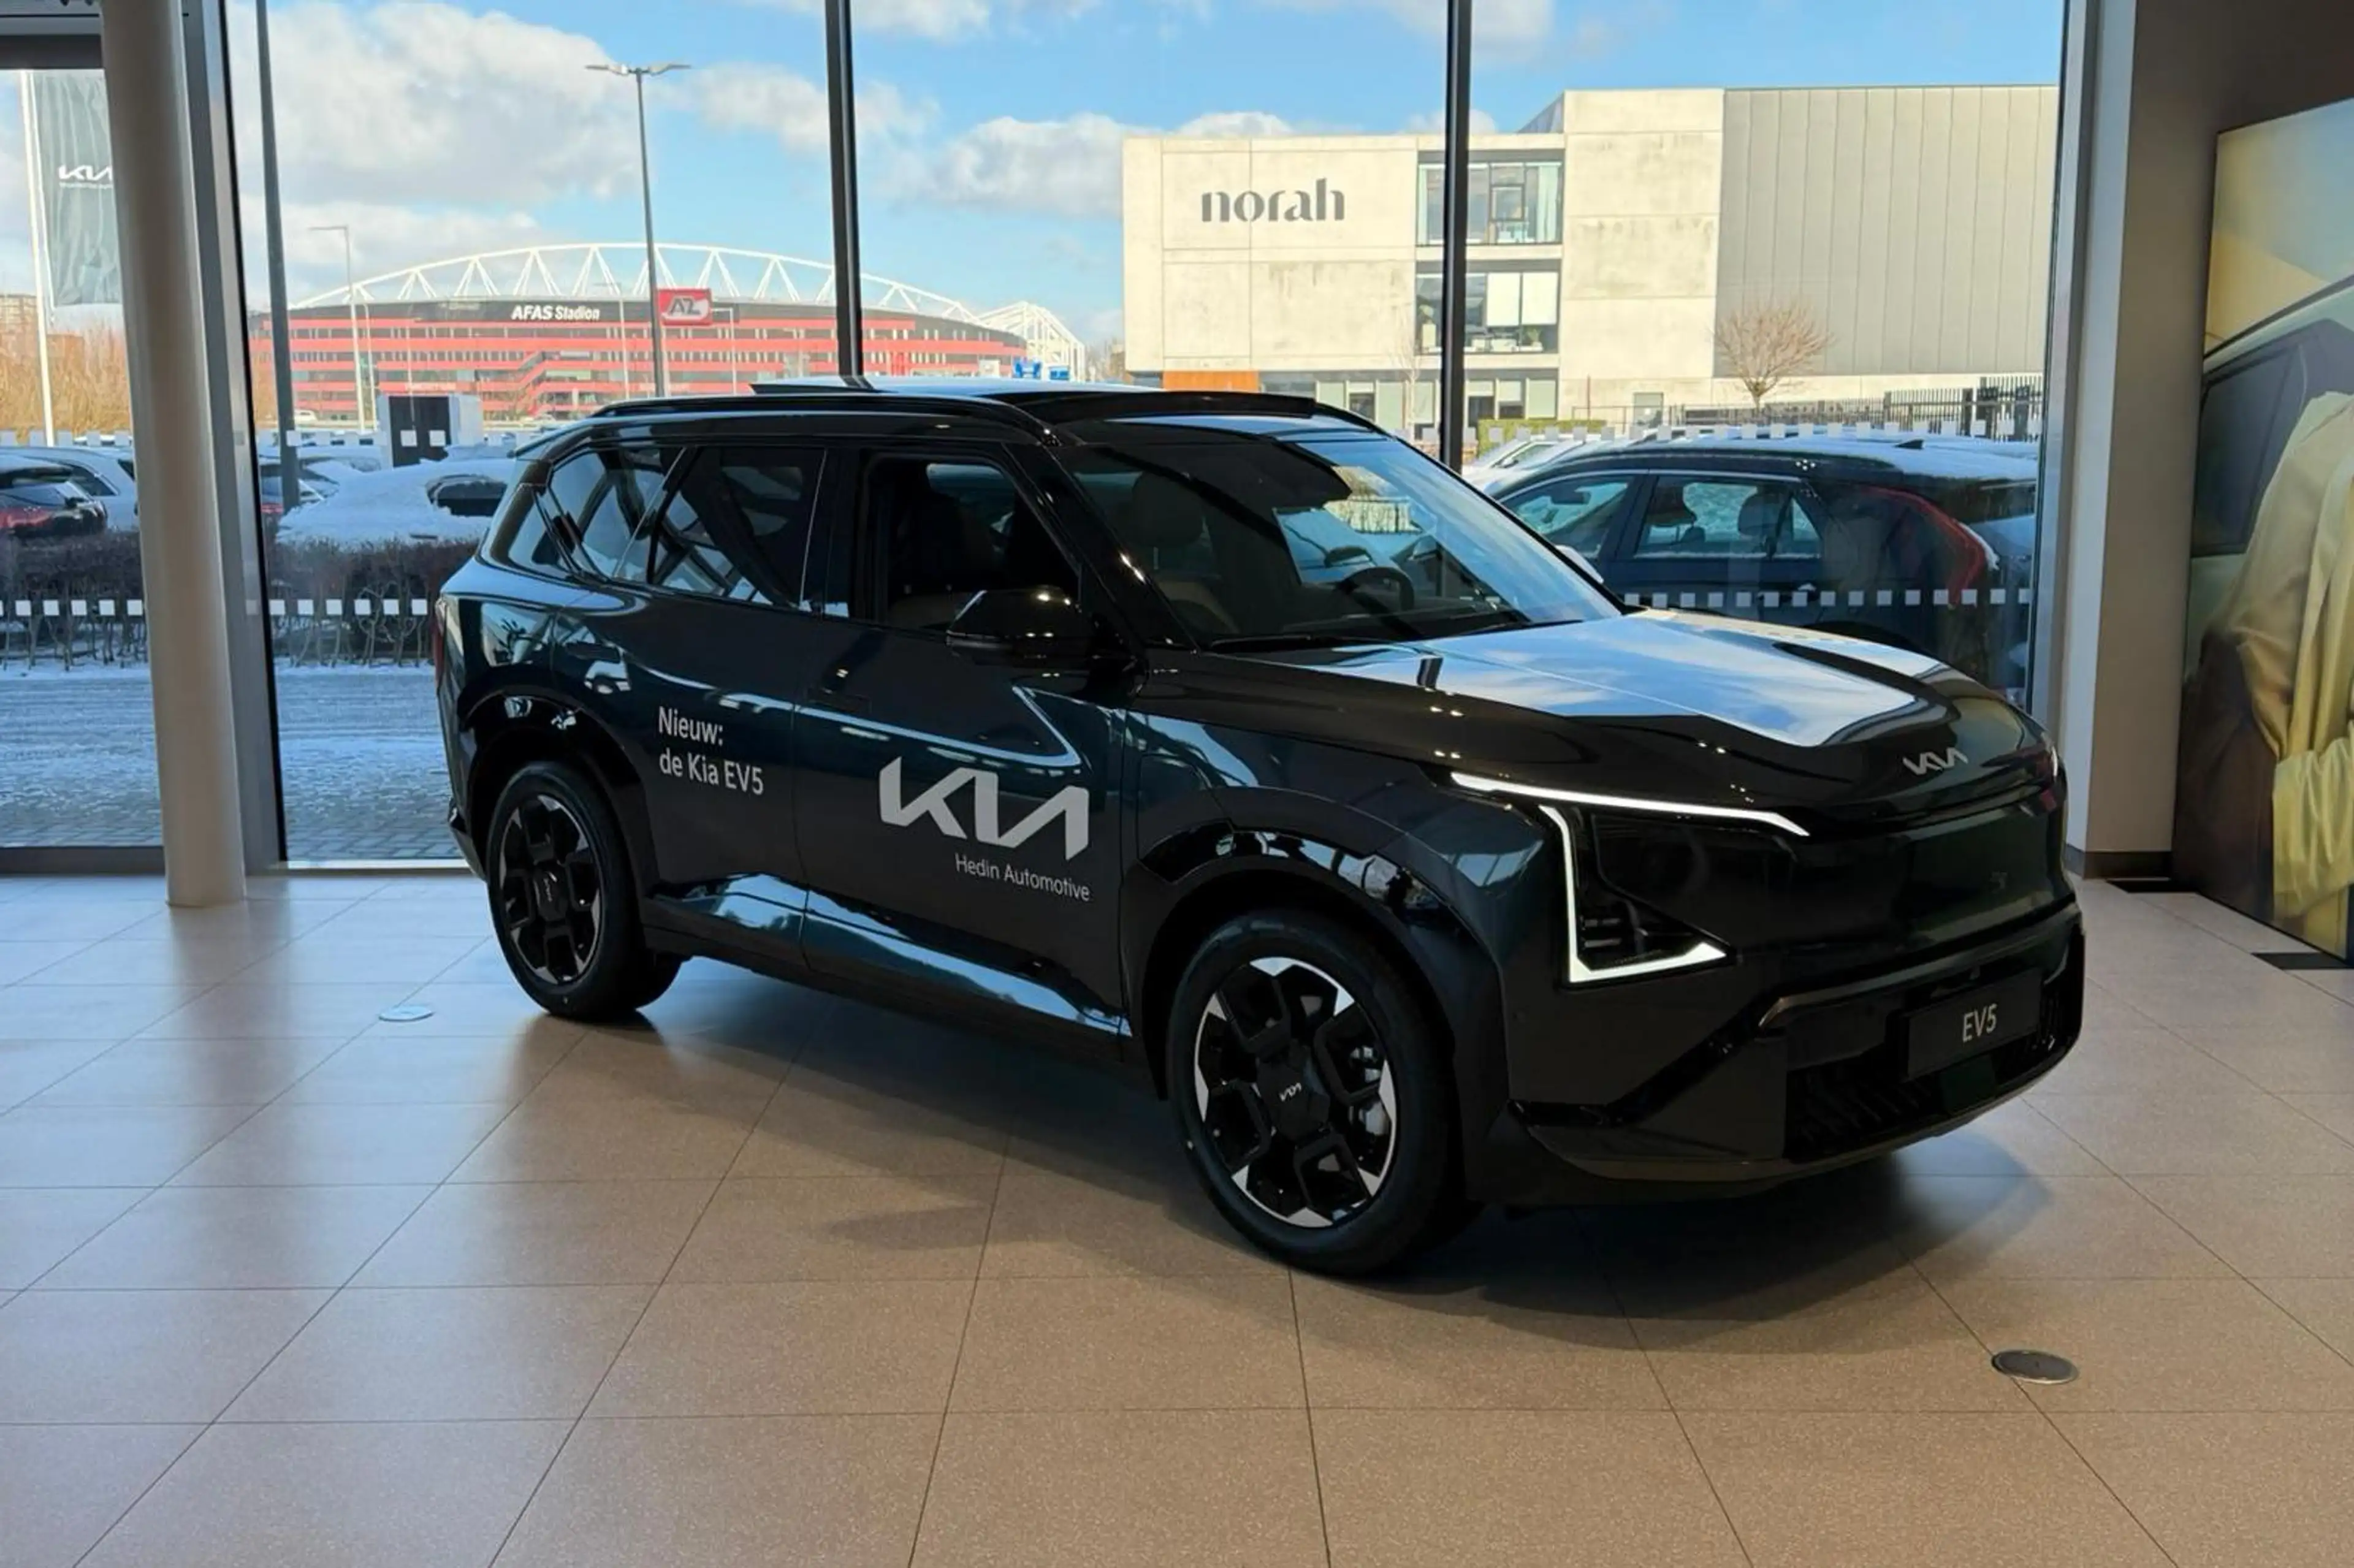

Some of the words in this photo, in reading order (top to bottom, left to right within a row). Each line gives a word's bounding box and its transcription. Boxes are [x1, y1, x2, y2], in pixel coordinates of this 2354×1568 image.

[1202, 177, 1345, 223] norah
[511, 305, 552, 321] AFAS
[554, 305, 600, 321] Stadion
[669, 297, 703, 316] AZ
[658, 706, 723, 747] Nieuw:
[659, 747, 684, 778] de
[687, 752, 720, 786] Kia
[723, 759, 764, 796] EV5
[1902, 747, 1969, 775] KIA
[879, 756, 1090, 861] KIA
[954, 853, 1000, 880] Hedin
[1004, 864, 1091, 902] Automotive
[1962, 1003, 1998, 1043] EV5
